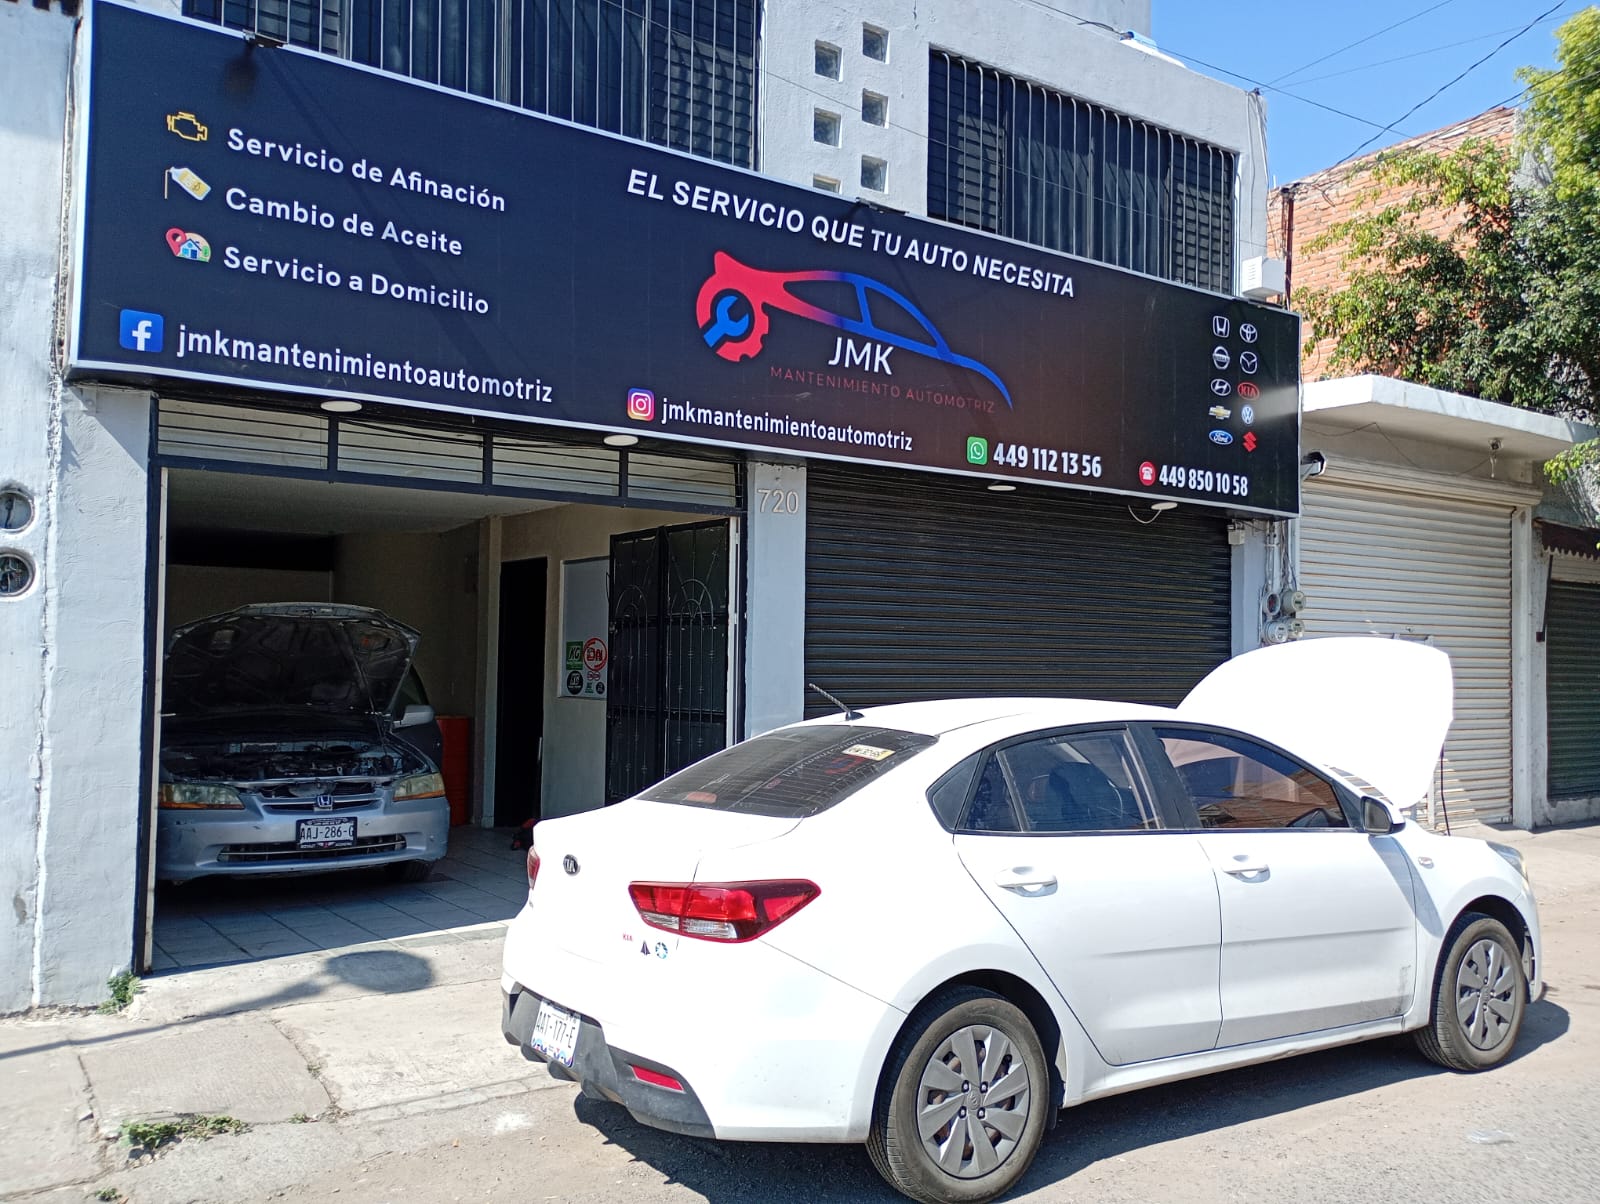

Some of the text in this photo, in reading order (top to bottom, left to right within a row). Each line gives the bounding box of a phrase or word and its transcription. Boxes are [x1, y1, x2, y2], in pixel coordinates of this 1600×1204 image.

[227, 128, 506, 212] Servicio de Afinación
[225, 187, 463, 256] Cambio de Aceite
[627, 168, 1075, 298] EL SERVICIO QUE TU AUTO NECESITA
[223, 246, 490, 314] Servicio a Domicilio
[176, 324, 554, 403] jmkmantenimientoautomotriz
[828, 336, 895, 375] JMK
[770, 366, 996, 414] MANTENIMIENTO AUTOMOTRIZ
[661, 397, 914, 452] jmkmantenimientoautomotriz
[993, 442, 1102, 478] 449 112 13 56
[1158, 464, 1249, 497] 449 850 10 58
[757, 489, 799, 514] 720
